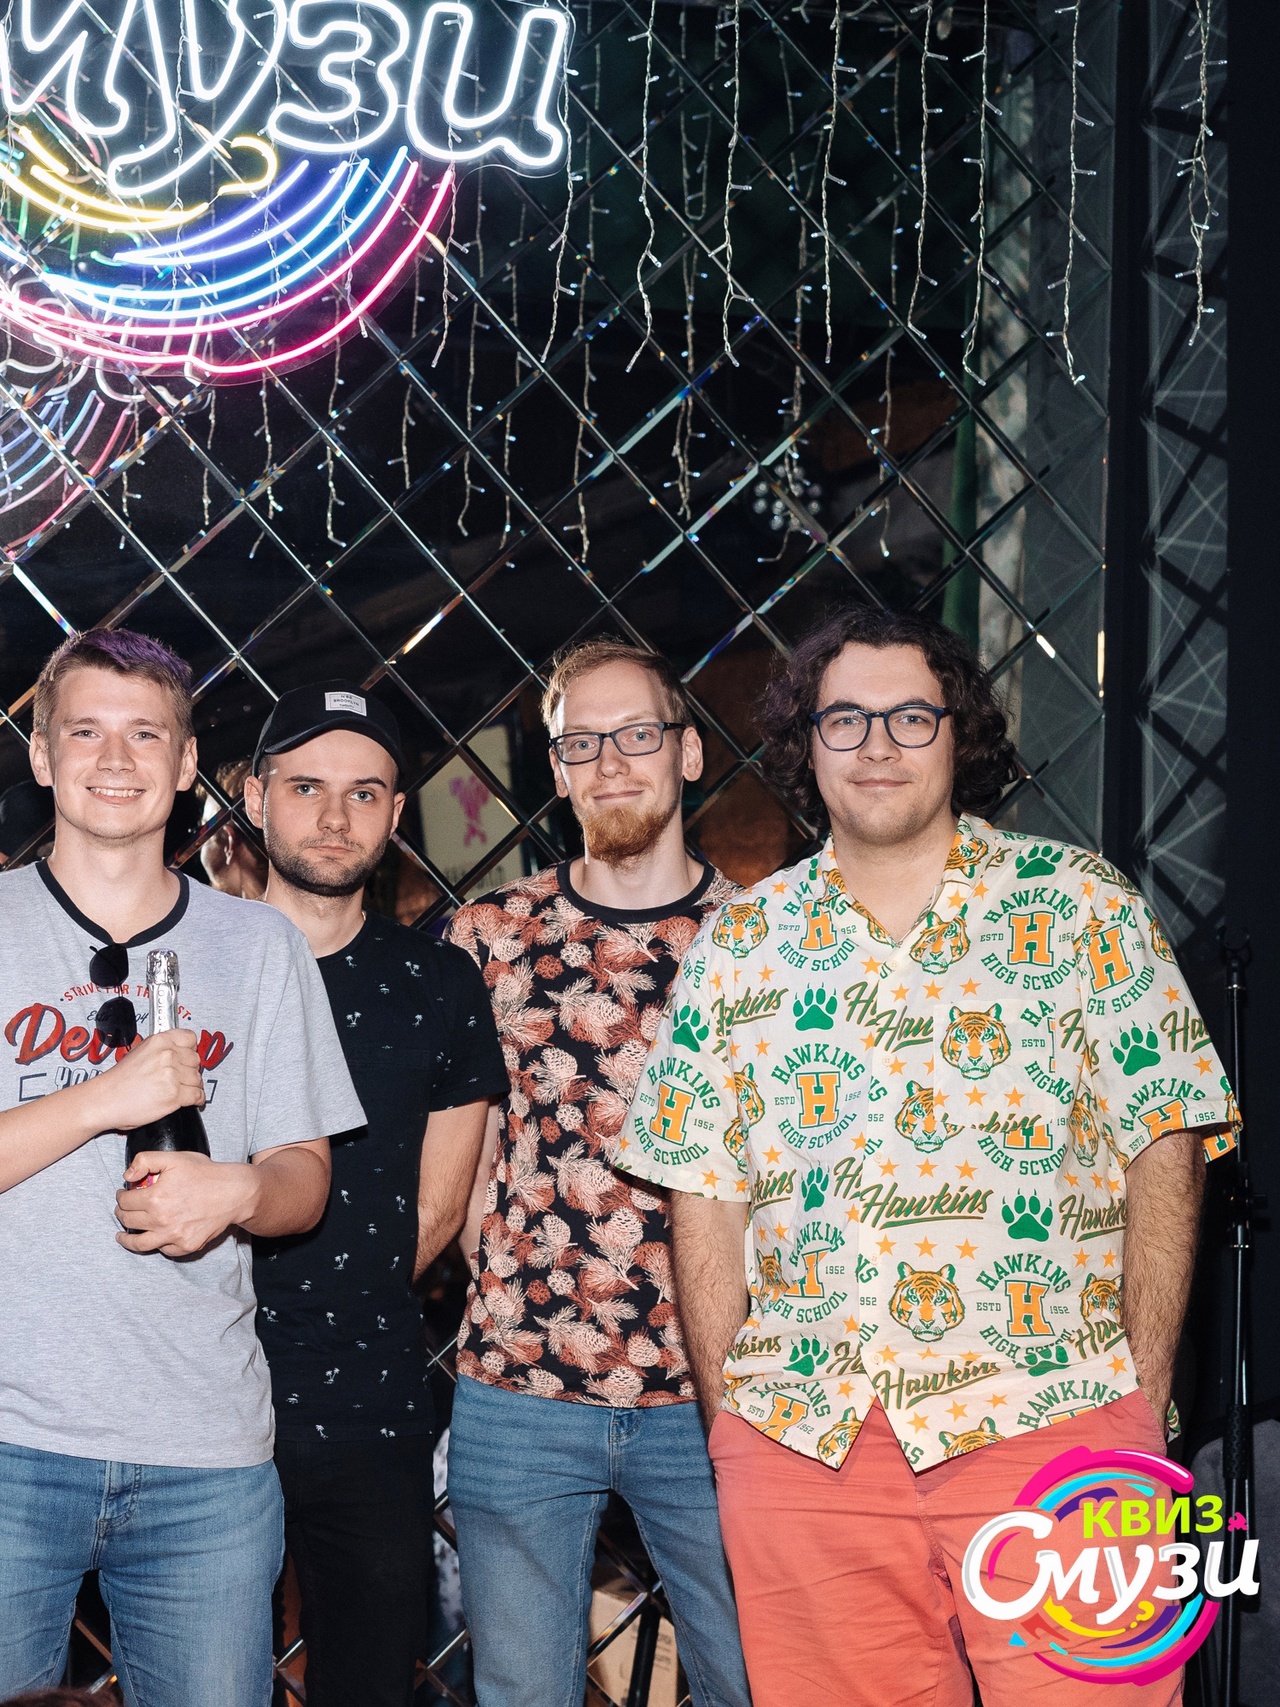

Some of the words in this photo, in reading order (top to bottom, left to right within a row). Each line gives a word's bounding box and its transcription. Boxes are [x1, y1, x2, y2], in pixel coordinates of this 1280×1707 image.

[983, 887, 1078, 924] HAWKINS
[778, 923, 800, 932] ESTD
[841, 925, 857, 935] 952
[980, 933, 1004, 942] ESTD
[1007, 911, 1055, 967] H
[777, 940, 809, 969] HIGH
[811, 937, 856, 971] SCHOO
[980, 952, 1016, 986] HIGH
[1022, 957, 1077, 991] SCHOOL
[1112, 965, 1155, 1014] SCHOOL
[1021, 1039, 1046, 1047] ESTD
[646, 1057, 721, 1110] HAWKINS
[770, 1043, 866, 1085] HAWKINS
[640, 1093, 656, 1107] ESTD
[650, 1080, 696, 1146] H
[693, 1117, 715, 1131] 1952
[775, 1096, 796, 1105] ESTD
[795, 1071, 842, 1128] H
[867, 1113, 884, 1122] 952
[1119, 1077, 1206, 1132] HAWKINS
[634, 1116, 653, 1153] HIGH
[653, 1143, 709, 1166] SCHOOL
[778, 1118, 806, 1150] HIGH
[808, 1112, 857, 1150] SCHOOL
[1129, 1136, 1146, 1152] ESTD
[1194, 1111, 1217, 1122] 1952
[977, 1134, 1015, 1172] HIGH
[860, 1182, 994, 1229] Hawkins
[825, 1265, 845, 1275] 1952
[976, 1253, 1071, 1293] HAWKINS
[796, 1291, 848, 1323] SCHOOL
[859, 1296, 877, 1306] 952
[976, 1302, 1002, 1312] ESTD
[1005, 1279, 1055, 1337] H
[1050, 1305, 1070, 1315] 1952
[979, 1324, 1021, 1361] HIGH
[873, 1359, 1001, 1411] Hawkins
[747, 1404, 765, 1418] ESTD
